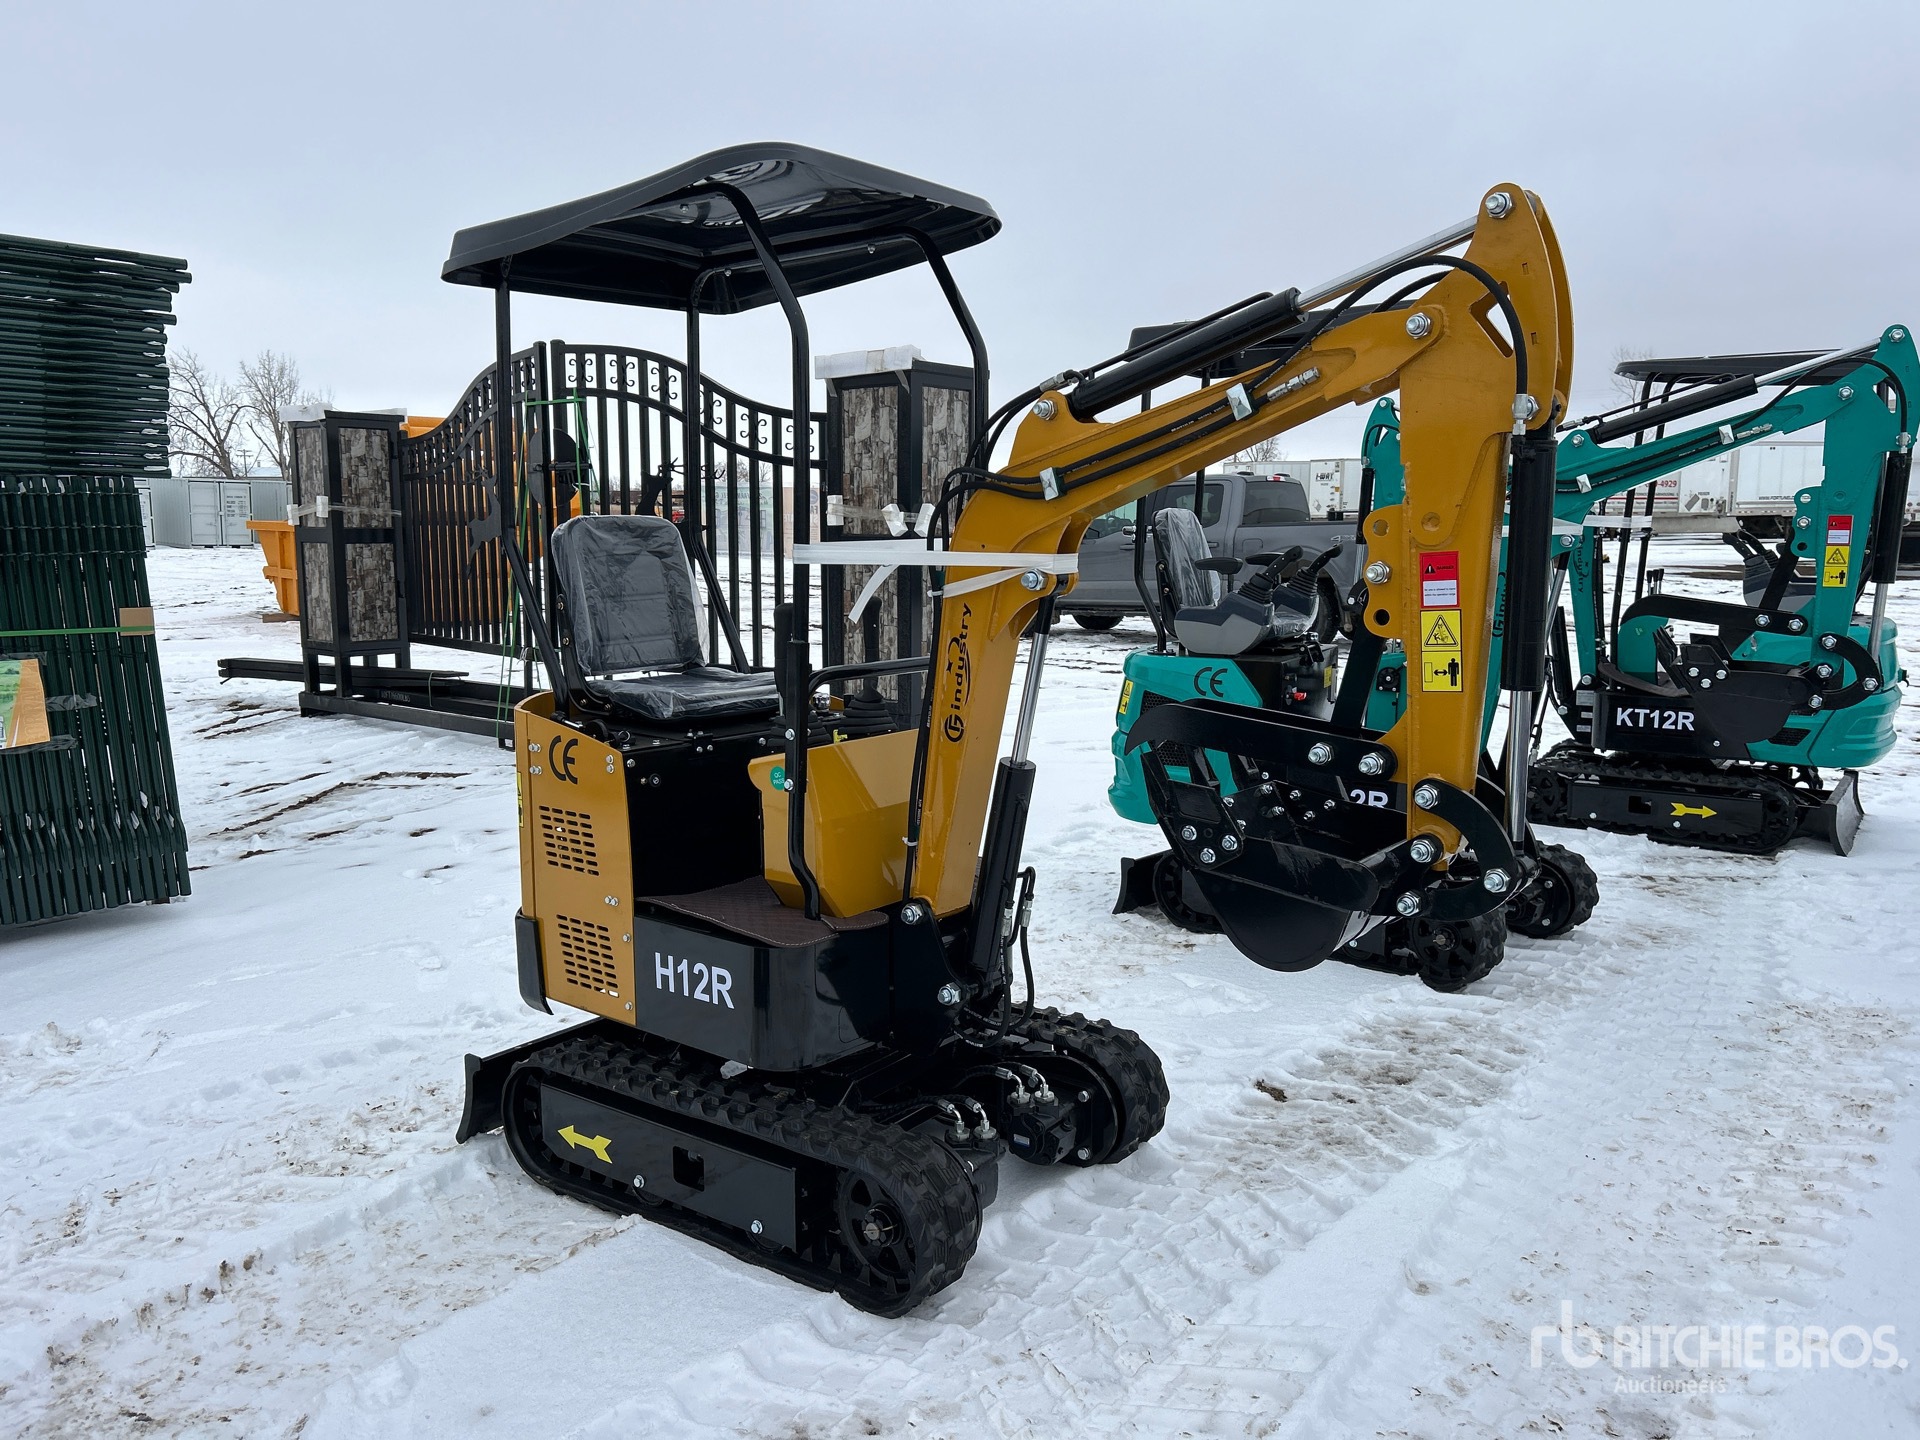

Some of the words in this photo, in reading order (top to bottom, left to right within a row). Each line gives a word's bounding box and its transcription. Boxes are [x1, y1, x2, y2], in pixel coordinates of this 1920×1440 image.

[1193, 666, 1229, 698] CE
[1616, 707, 1695, 731] KT12R
[548, 734, 579, 785] CE
[654, 951, 735, 1010] H12R
